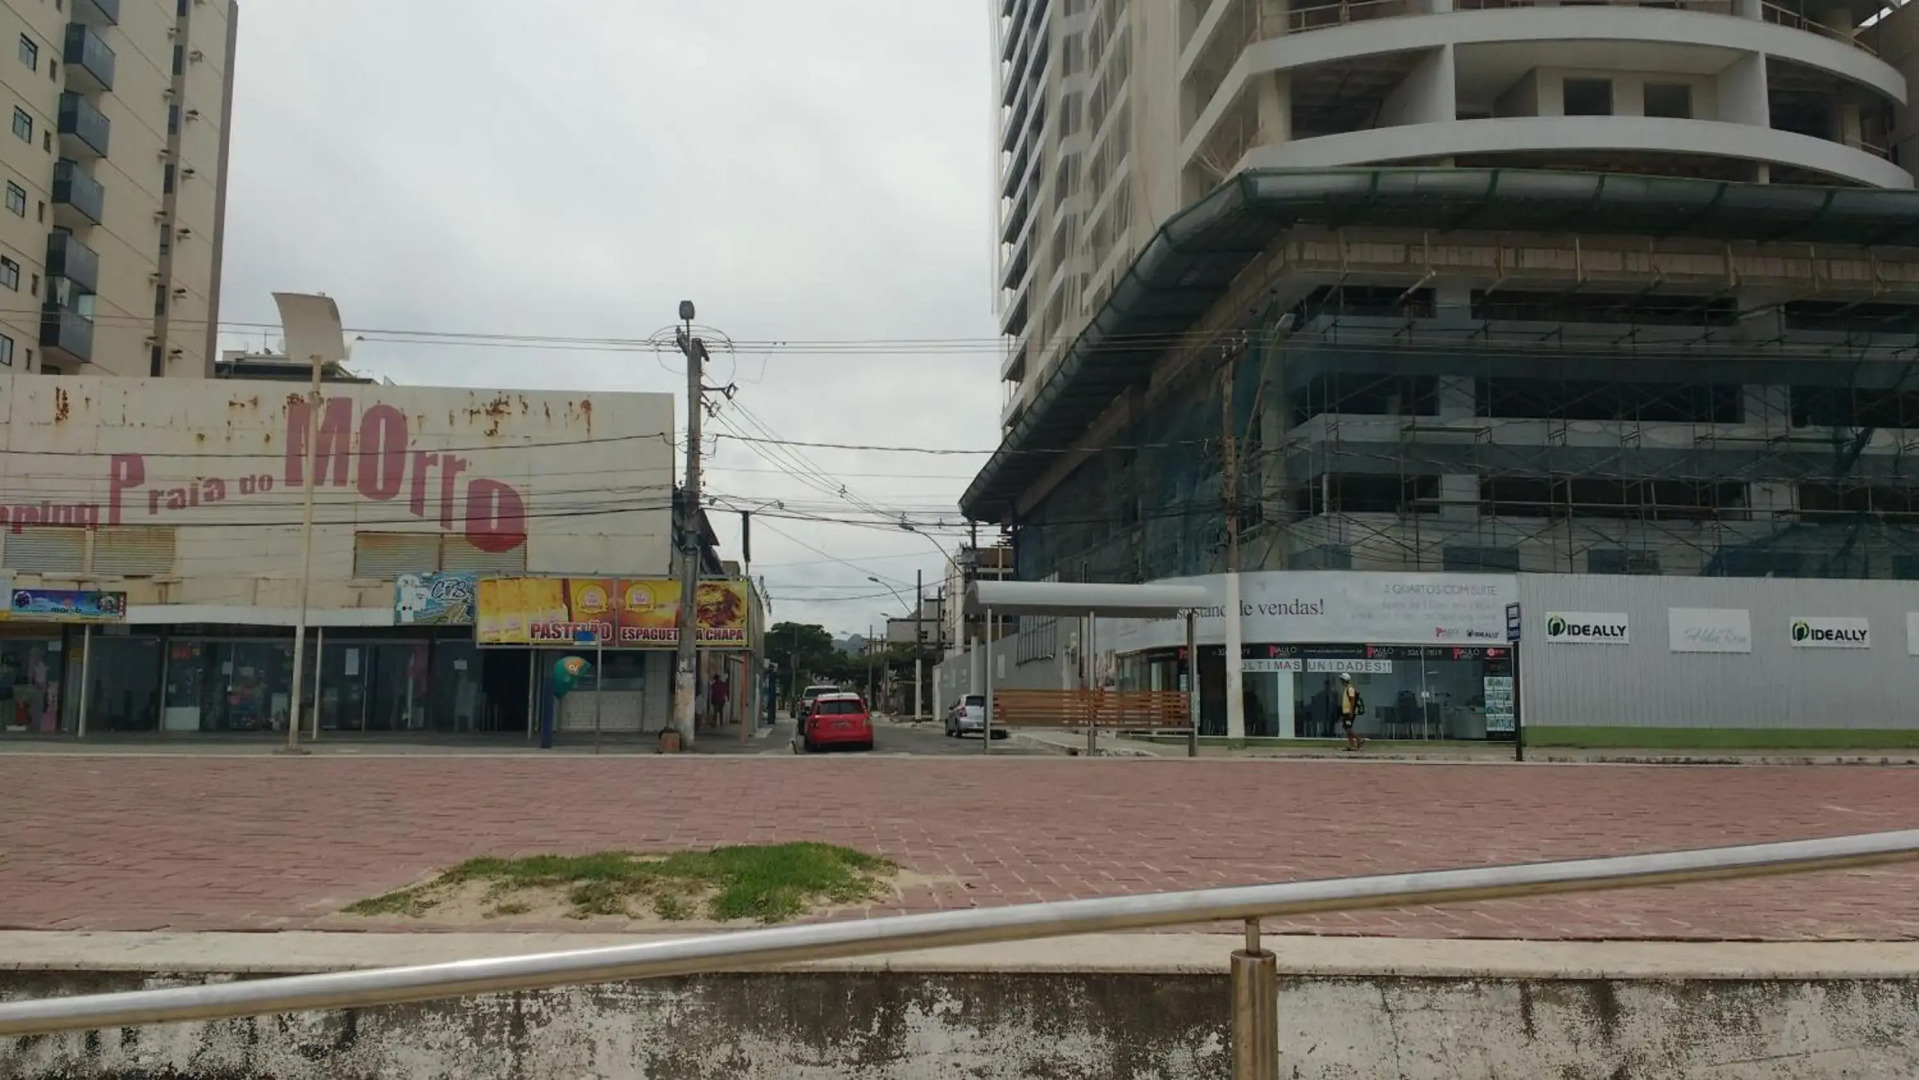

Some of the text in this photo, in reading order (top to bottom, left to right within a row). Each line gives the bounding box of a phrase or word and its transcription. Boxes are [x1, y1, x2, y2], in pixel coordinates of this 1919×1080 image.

[108, 453, 226, 527] Praia
[239, 474, 274, 496] do
[1392, 583, 1443, 595] QUARTOS
[1443, 584, 1470, 596] COM
[1258, 598, 1325, 617] vendas!
[621, 628, 680, 642] ESPAGUET
[705, 628, 744, 641] CHAPA
[1567, 624, 1628, 637] IDEALLY
[1810, 628, 1868, 641] IDEALLY
[1268, 645, 1297, 658] PAULO
[1366, 645, 1394, 658] PAULO
[1453, 646, 1480, 660] PAULO
[1308, 660, 1392, 672] UNIDADES!!
